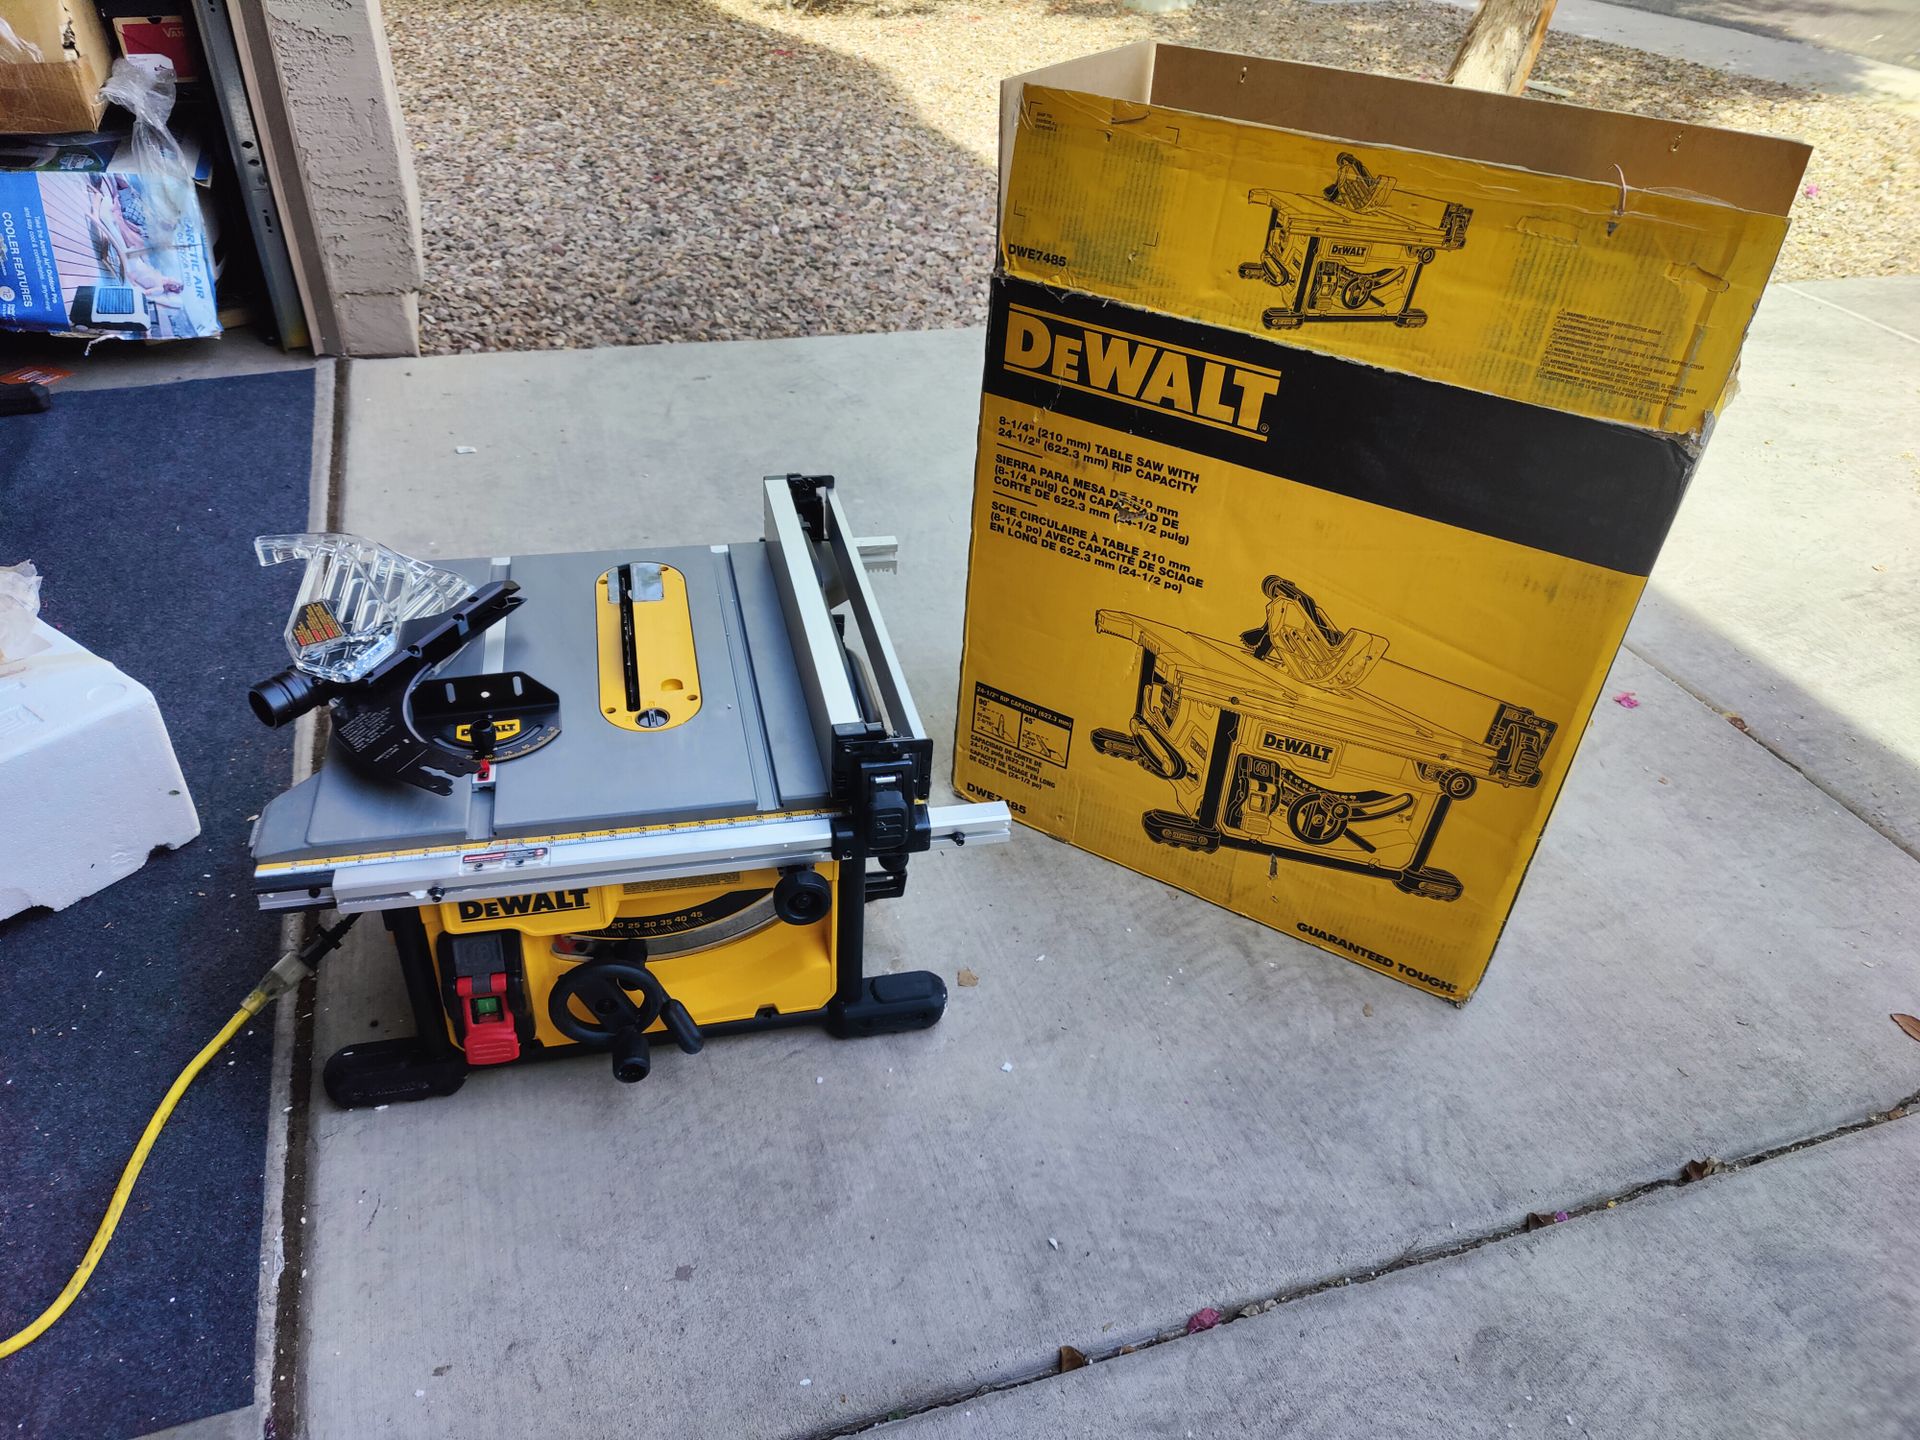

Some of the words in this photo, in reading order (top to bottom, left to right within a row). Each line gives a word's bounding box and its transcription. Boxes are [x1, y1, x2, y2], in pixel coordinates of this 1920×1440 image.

[1, 210, 19, 255] COOLER
[12, 255, 33, 308] FEATURES
[1008, 243, 1067, 267] DWE7485
[1331, 244, 1366, 256] DEWALT
[192, 275, 206, 299] AIR
[1004, 310, 1281, 431] DEWALT
[997, 426, 1040, 448] 24-1/2"
[1043, 440, 1079, 461] (622.3
[1083, 452, 1108, 469] mm)
[1111, 460, 1132, 475] RIP
[1135, 467, 1197, 495] CAPACITY
[998, 415, 1034, 434] 8-1/4"
[1037, 426, 1062, 444] (210
[1066, 435, 1090, 452] mm)
[1094, 443, 1132, 463] TABLE
[1136, 456, 1163, 473] SAW
[1167, 465, 1199, 483] WITH
[993, 475, 1031, 495] CORTE
[1034, 487, 1050, 500] DE
[1053, 494, 1085, 512] 622.3
[1088, 507, 1110, 519] mm
[1159, 527, 1189, 546] pulg)
[994, 464, 1027, 483] (8-1/4
[1030, 476, 1058, 494] pulg)
[1060, 485, 1083, 501] CON
[1161, 516, 1179, 530] DE
[995, 453, 1036, 474] SIERRA
[1039, 467, 1069, 485] PARA
[1072, 477, 1106, 495] MESA
[1156, 504, 1178, 518] mm
[989, 510, 1022, 530] (8-1/4
[1025, 522, 1042, 537] po)
[1044, 529, 1074, 546] AVEC
[1077, 538, 1135, 566] CAPACITÉ
[1138, 559, 1155, 573] DE
[1158, 567, 1204, 588] SCIAGE
[989, 521, 1004, 534] EN
[1007, 527, 1038, 545] LONG
[1040, 538, 1056, 551] DE
[1059, 544, 1091, 563] 622.3
[1094, 557, 1115, 571] mm
[1118, 563, 1161, 586] (24-1/2
[1164, 579, 1182, 594] po)
[991, 500, 1016, 517] SCIE
[1019, 510, 1087, 539] CIRCULAIRE
[1090, 530, 1099, 543] À
[1101, 536, 1139, 556] TABLE
[1142, 549, 1165, 564] 210
[1168, 559, 1190, 573] mm
[1264, 733, 1334, 761] DEWALT
[458, 888, 589, 919] DEWALT
[660, 918, 673, 926] 35
[1296, 922, 1394, 968] GUARANTEED
